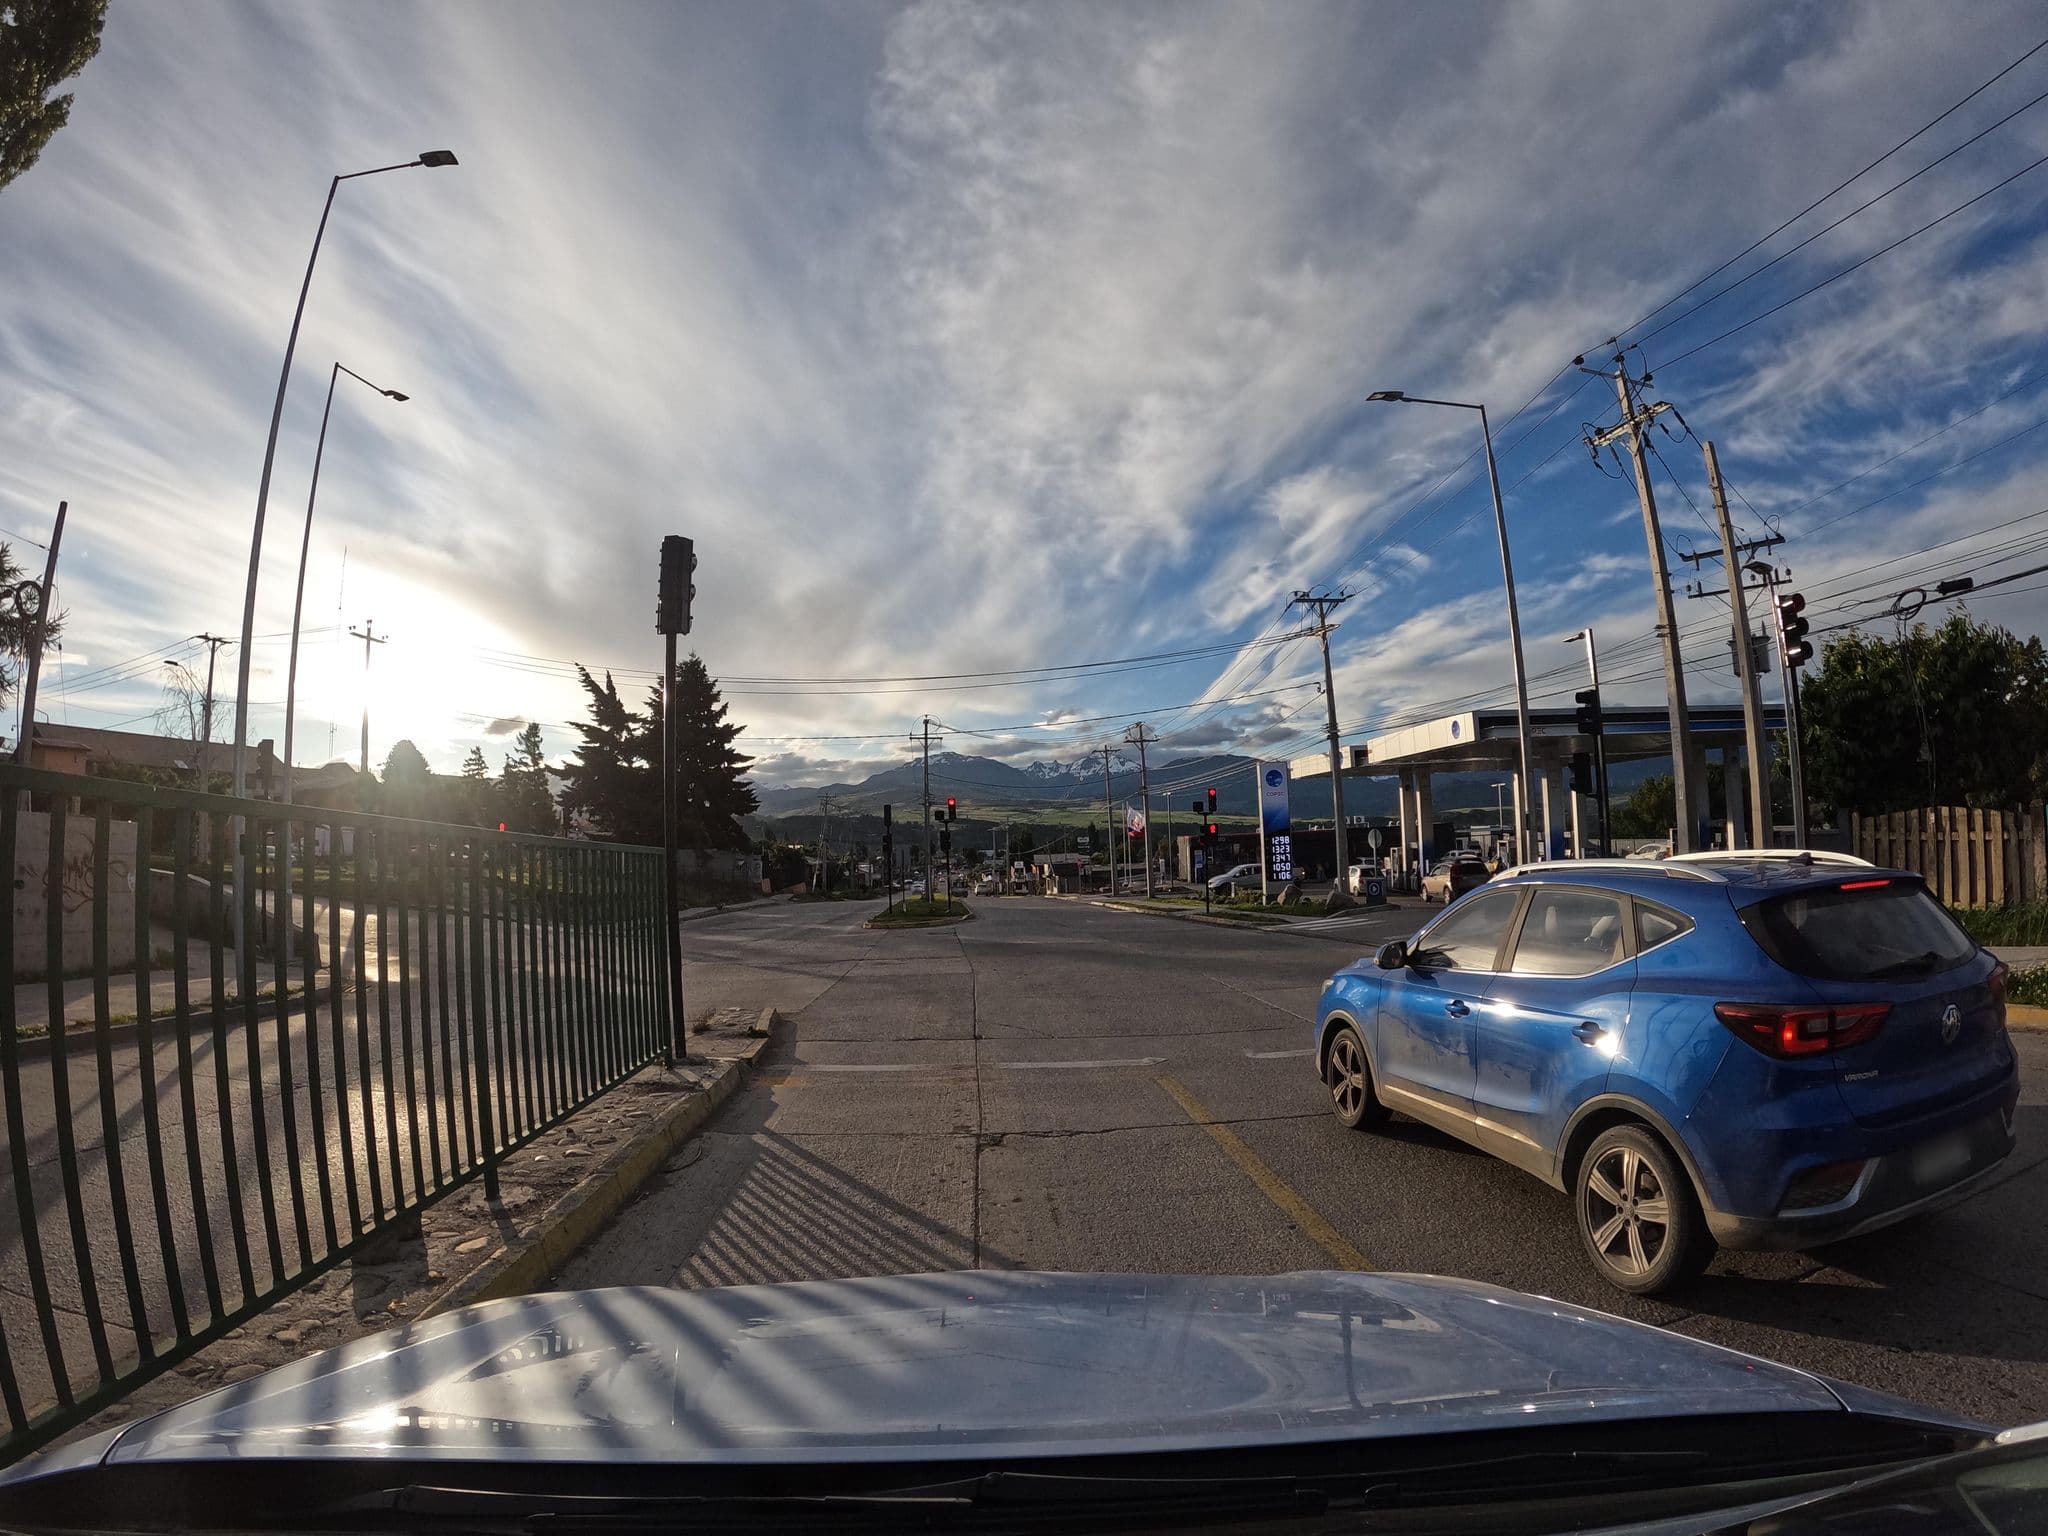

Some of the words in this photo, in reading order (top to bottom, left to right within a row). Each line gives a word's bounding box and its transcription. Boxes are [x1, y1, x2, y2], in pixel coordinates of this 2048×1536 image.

[1272, 835, 1290, 845] 1298
[1272, 844, 1290, 854] 1323
[1273, 853, 1290, 862] 1347
[1273, 862, 1290, 871] 1050
[1273, 871, 1291, 879] 1106
